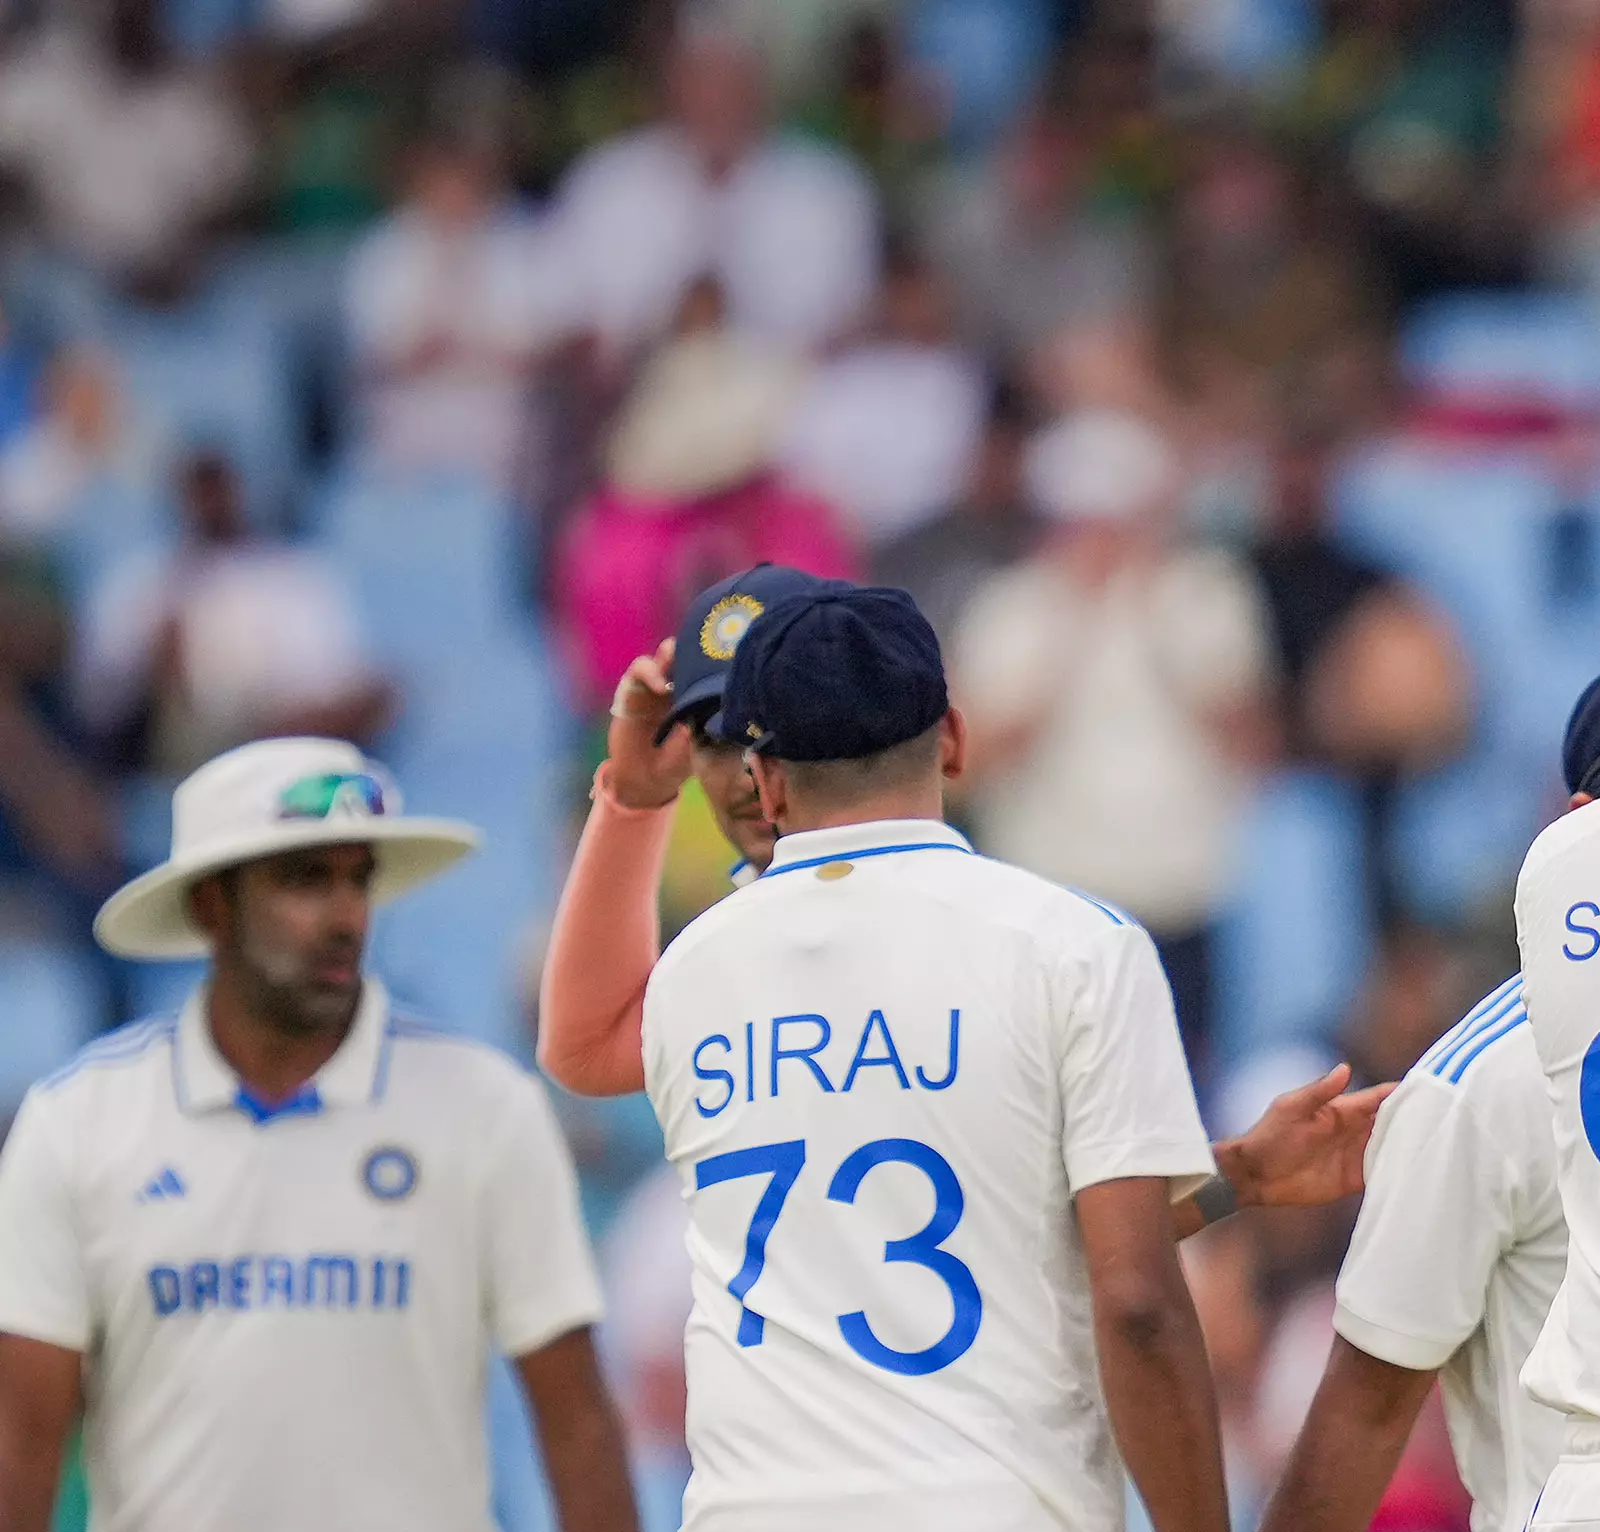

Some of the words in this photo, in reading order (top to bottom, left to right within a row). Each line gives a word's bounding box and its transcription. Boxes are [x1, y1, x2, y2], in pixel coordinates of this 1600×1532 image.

[693, 1009, 961, 1119] SIRAJ
[149, 1253, 411, 1317] DREAM11
[695, 1138, 983, 1377] 73
